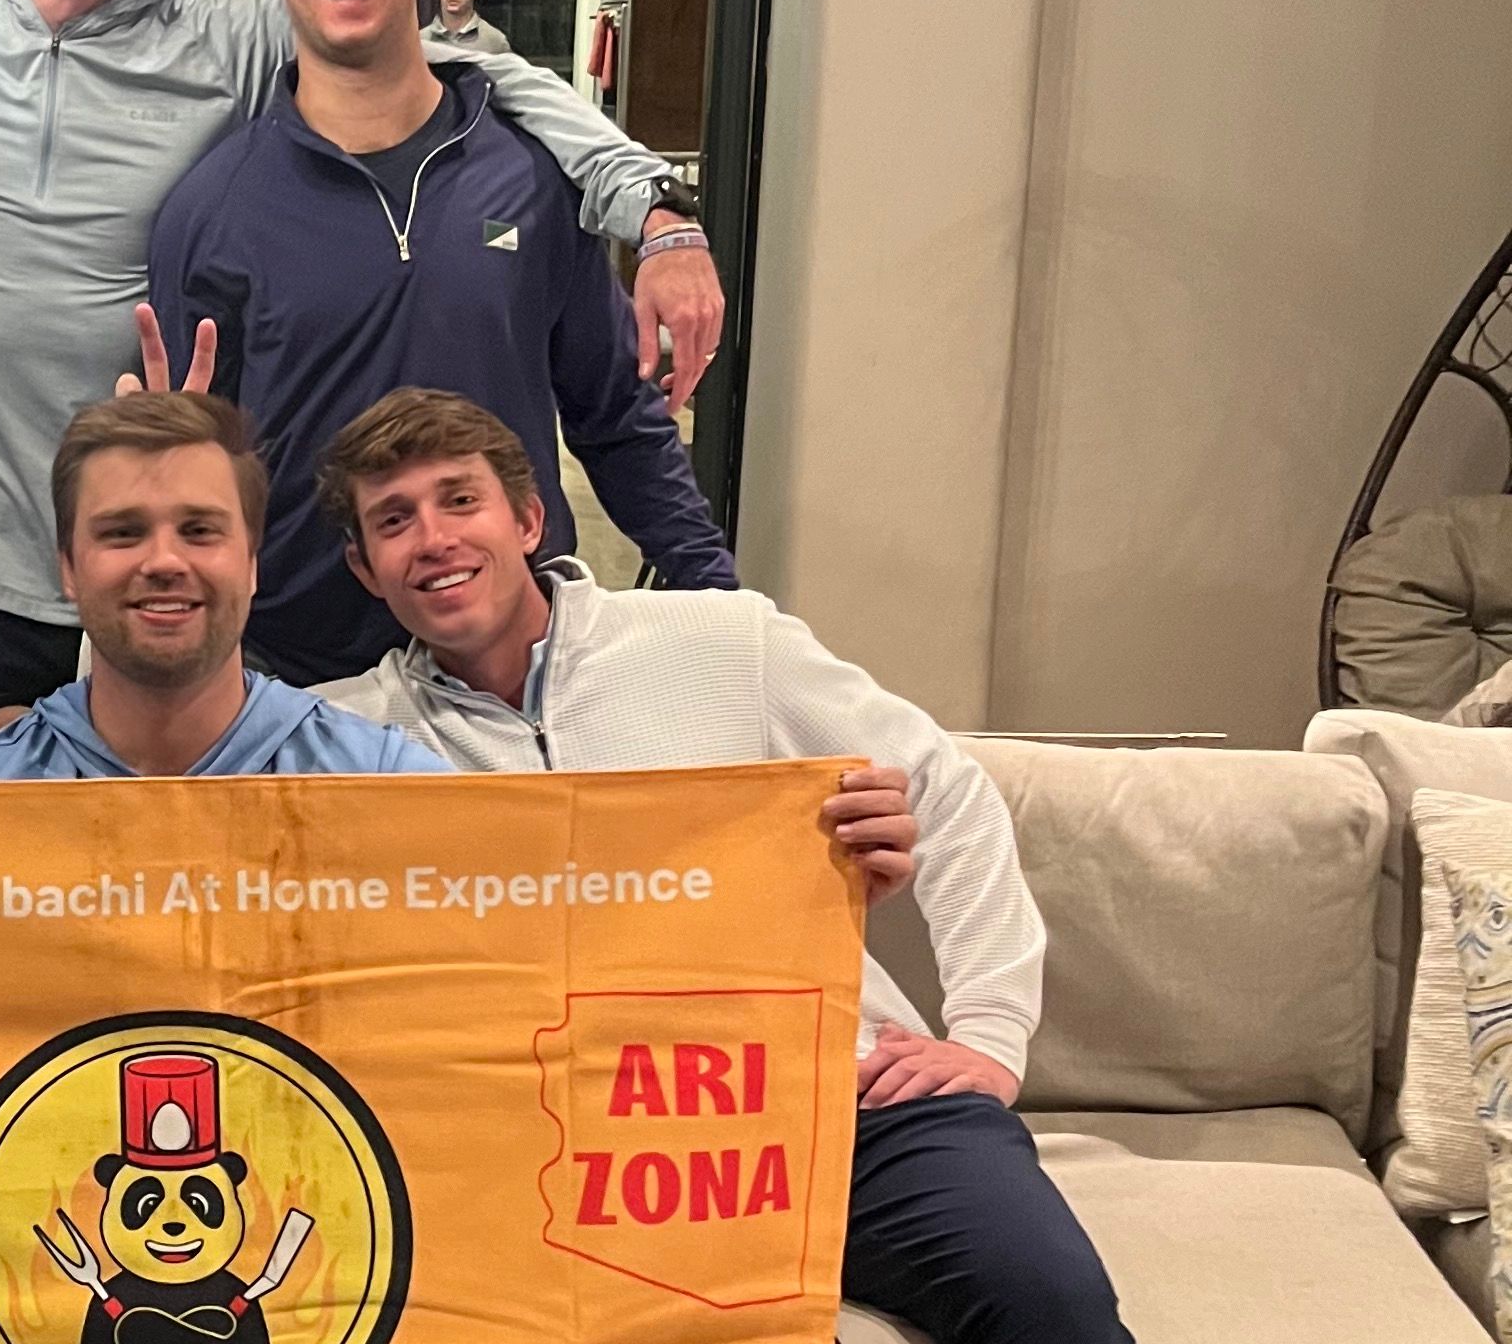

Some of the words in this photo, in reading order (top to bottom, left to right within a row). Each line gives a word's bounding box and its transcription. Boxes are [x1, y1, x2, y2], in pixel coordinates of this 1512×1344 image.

[162, 872, 222, 915] At
[236, 869, 389, 912] Home
[404, 862, 713, 918] Experience
[608, 1042, 766, 1117] ARI
[573, 1144, 791, 1226] ZONA
